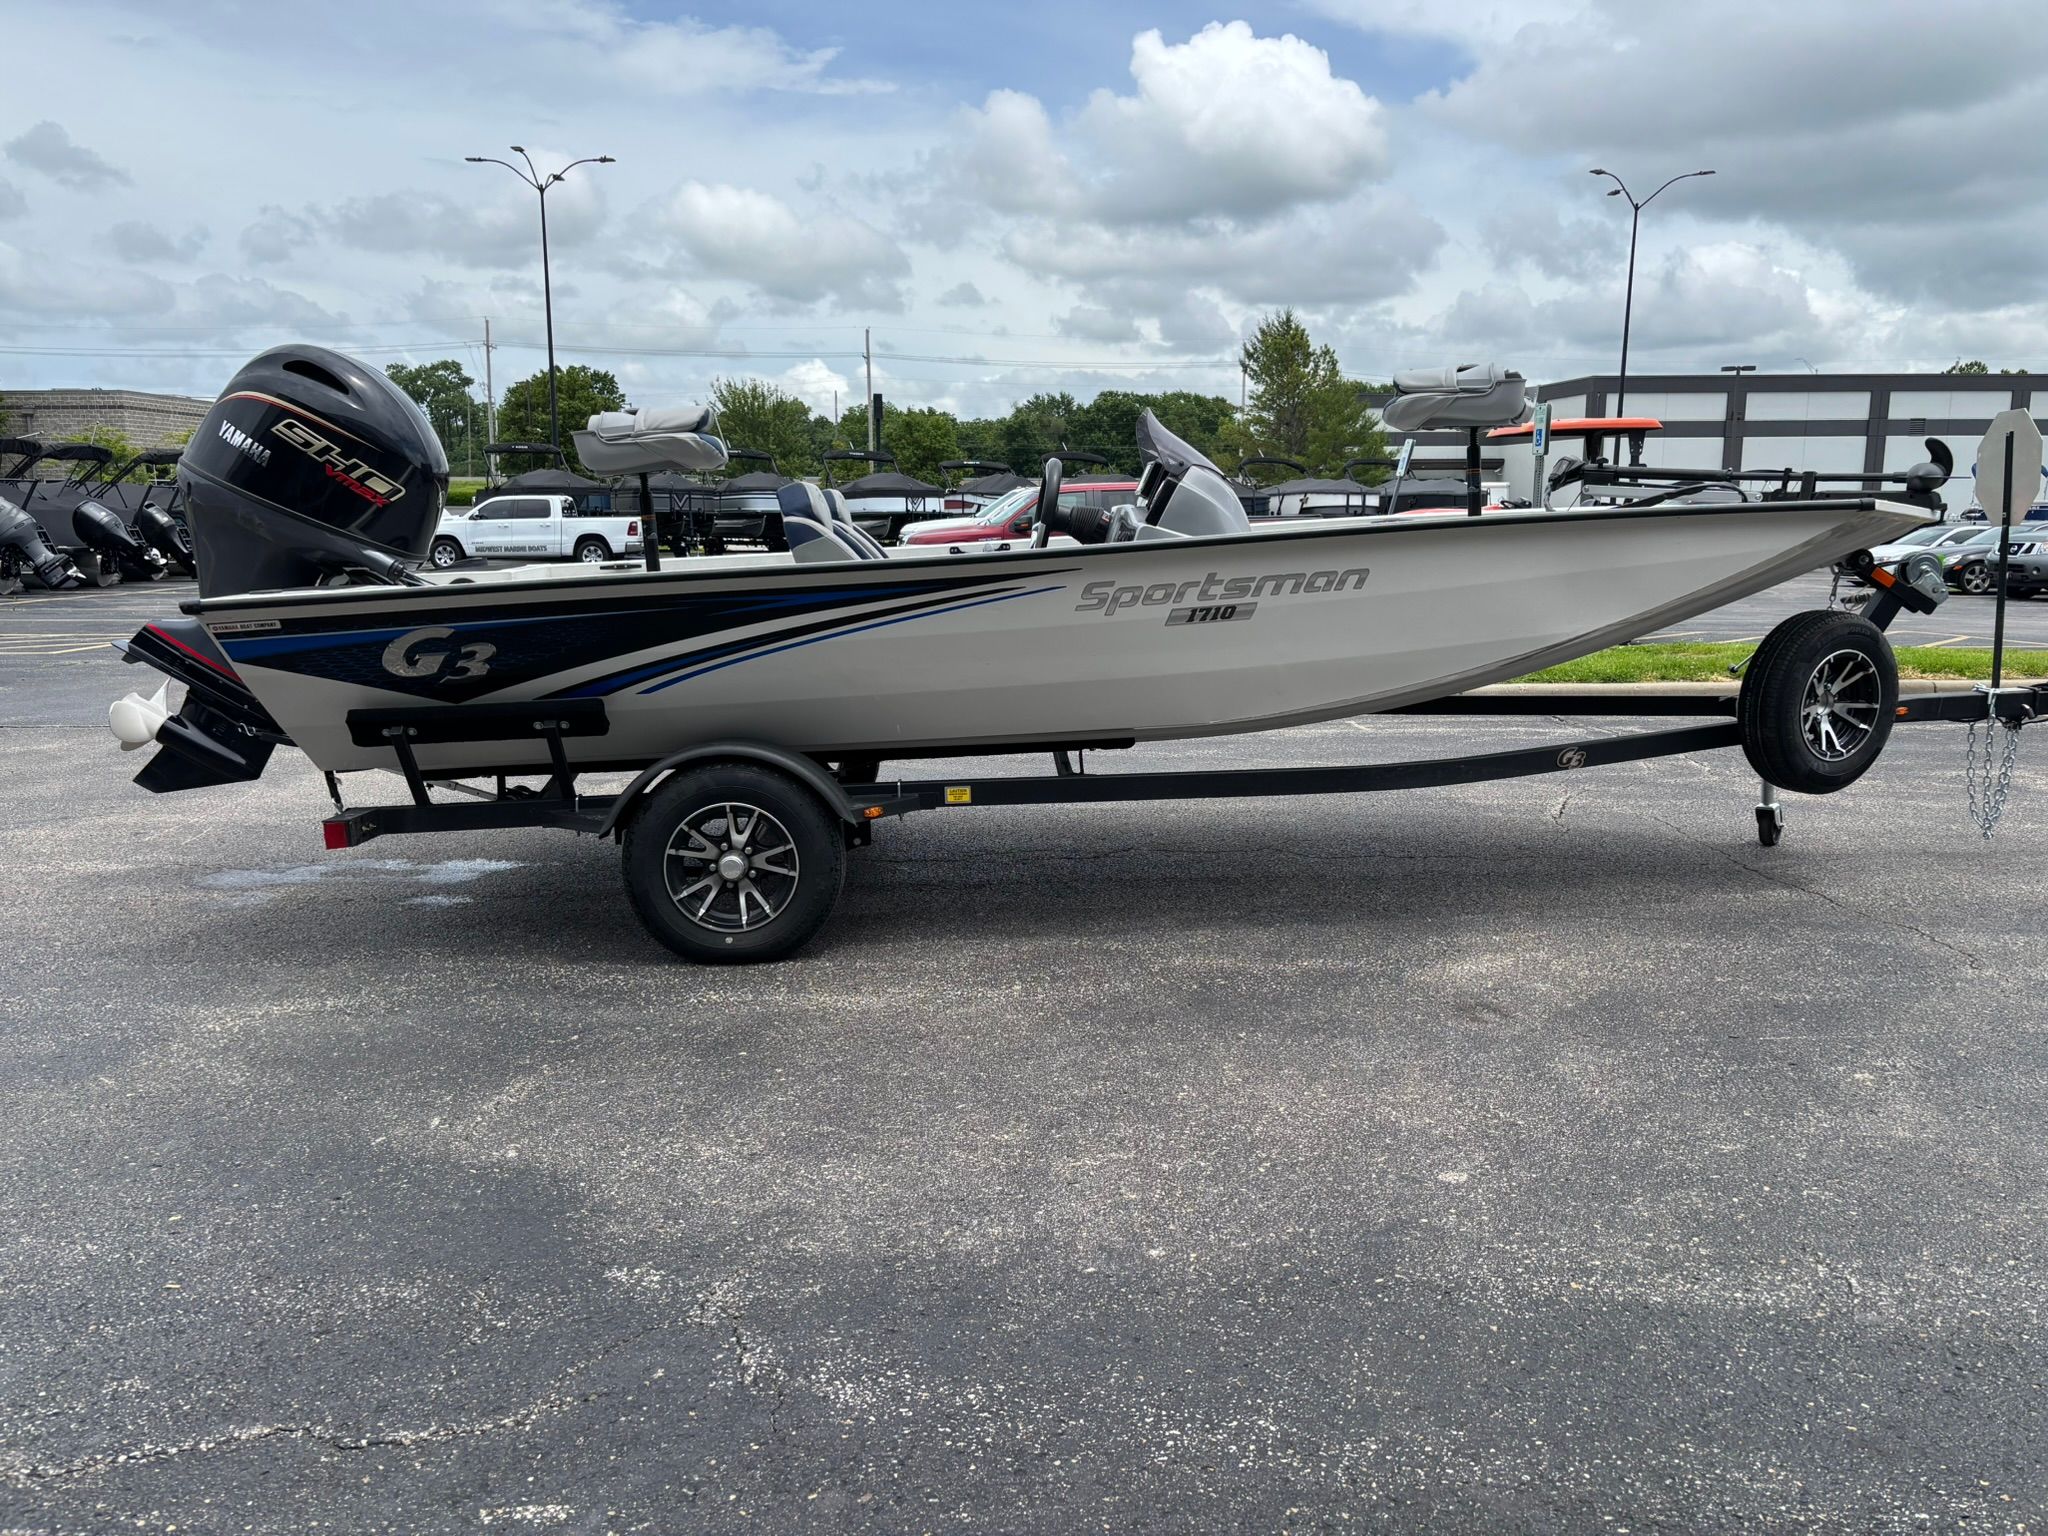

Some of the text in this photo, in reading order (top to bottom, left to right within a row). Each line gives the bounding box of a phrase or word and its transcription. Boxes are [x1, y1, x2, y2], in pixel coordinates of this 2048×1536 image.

[218, 420, 271, 467] YAMAHA
[271, 419, 405, 501] SHO
[1075, 568, 1370, 616] Sportsman
[1185, 605, 1237, 623] 1710
[382, 626, 496, 683] G3
